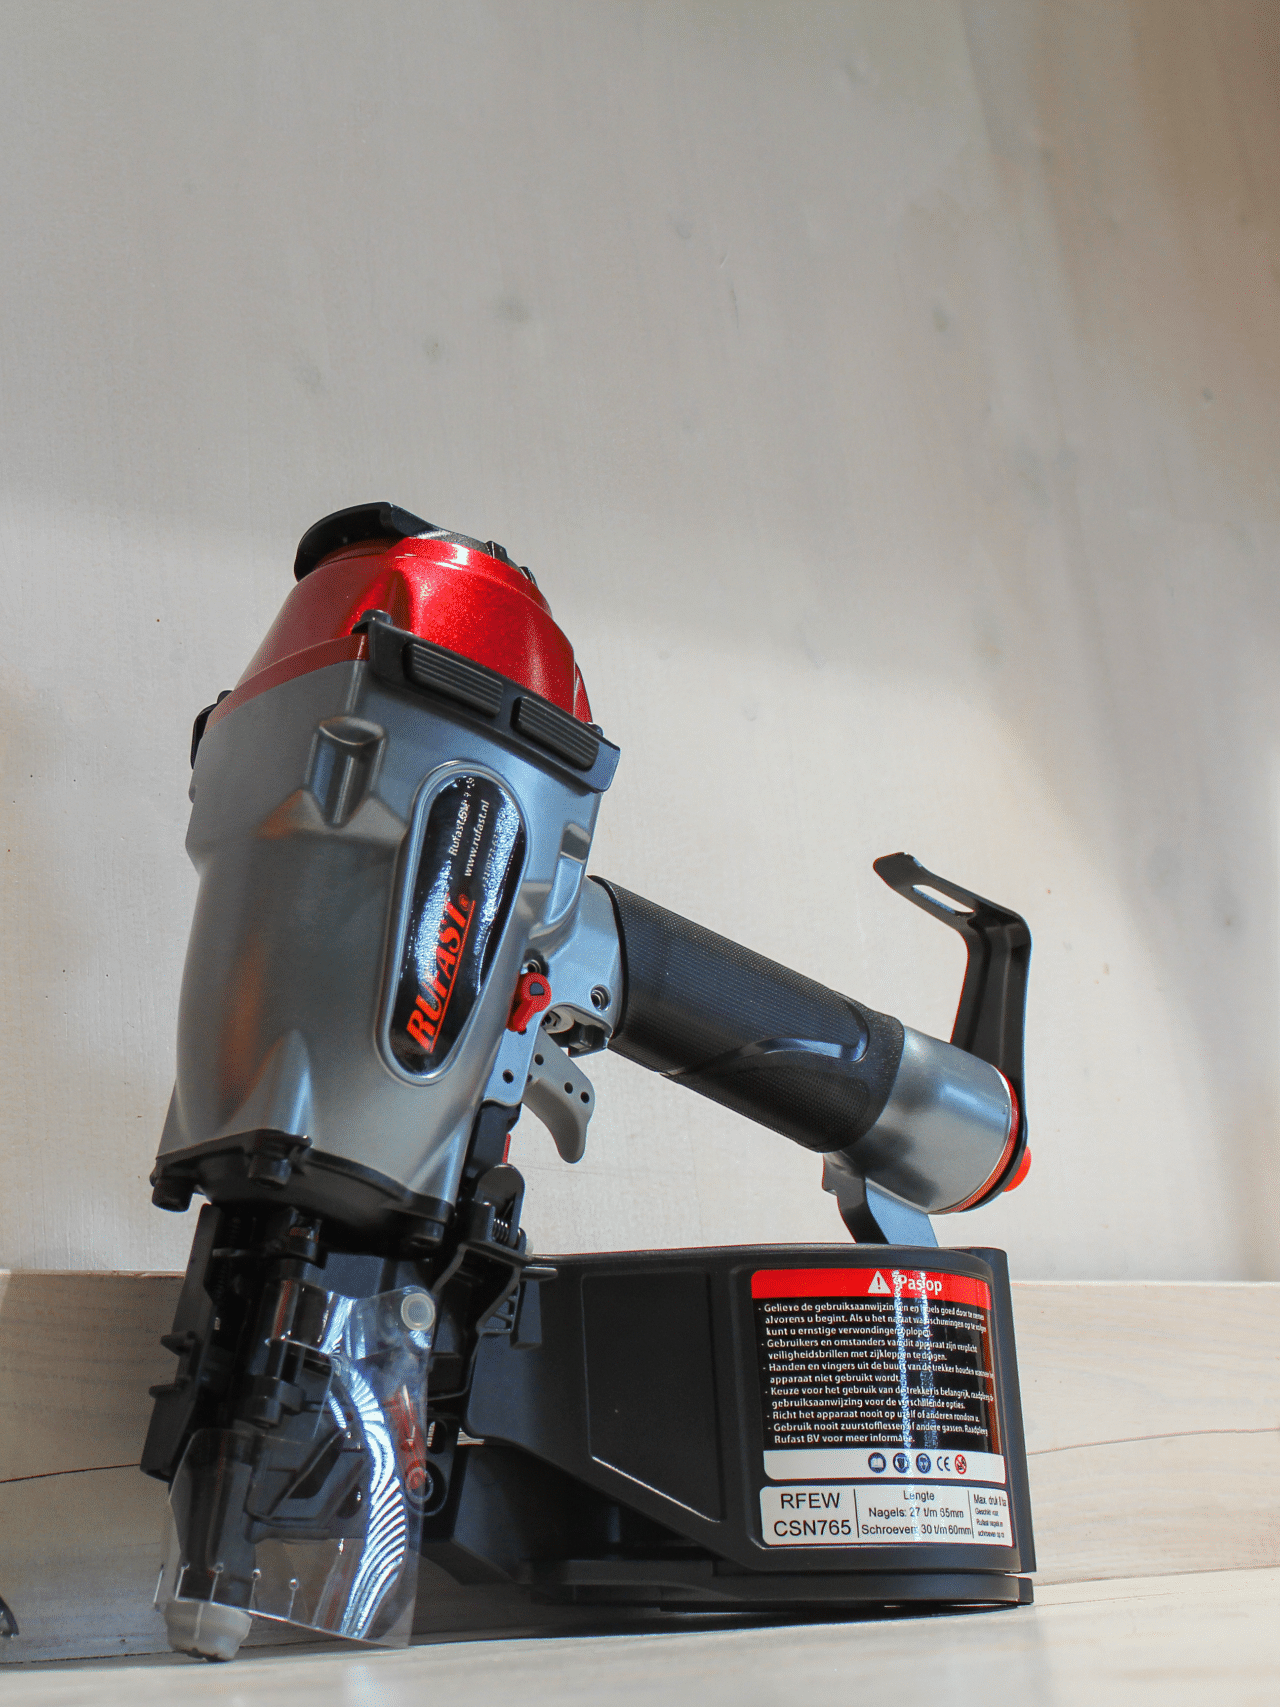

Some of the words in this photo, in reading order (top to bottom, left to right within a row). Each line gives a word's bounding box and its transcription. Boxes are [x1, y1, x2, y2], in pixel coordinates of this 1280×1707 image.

[448, 819, 465, 856] Rufast
[464, 799, 490, 877] www.rufast.nl
[406, 892, 467, 1051] RUFAST
[926, 1279, 942, 1296] op
[763, 1303, 800, 1312] Gelieve
[801, 1302, 813, 1311] de
[814, 1302, 909, 1313] gebruiksaanwijzinn
[909, 1305, 920, 1313] en
[940, 1306, 956, 1317] goed
[765, 1315, 805, 1324] alvorens
[815, 1314, 848, 1324] begint.
[849, 1314, 863, 1323] Als
[871, 1314, 887, 1322] het
[887, 1314, 913, 1324] naaat
[766, 1327, 789, 1336] kunt
[798, 1326, 837, 1336] ernstige
[766, 1339, 819, 1348] Gebruikers
[820, 1339, 833, 1347] en
[833, 1337, 886, 1347] omstanders
[903, 1338, 914, 1347] dit
[946, 1341, 957, 1351] zijn
[768, 1350, 849, 1361] veiligheidsbrillen
[850, 1350, 868, 1358] met
[912, 1351, 921, 1359] te
[768, 1363, 806, 1372] Handen
[808, 1363, 820, 1371] en
[821, 1361, 856, 1372] vingers
[857, 1361, 870, 1370] uit
[871, 1361, 882, 1370] de
[883, 1361, 906, 1370] buu
[907, 1363, 922, 1371] van
[932, 1363, 955, 1373] trekker
[770, 1375, 813, 1385] apparaat
[814, 1373, 833, 1382] niet
[834, 1373, 873, 1384] gebruikt
[770, 1386, 800, 1396] Keuze
[801, 1387, 824, 1395] voor
[825, 1385, 841, 1394] het
[842, 1385, 877, 1396] gebruik
[878, 1386, 894, 1394] van
[933, 1387, 939, 1396] is
[772, 1397, 863, 1409] gebruiksaanwijzing
[864, 1398, 884, 1406] voor
[885, 1397, 897, 1406] de
[897, 1397, 945, 1408] vschillende
[945, 1400, 966, 1410] opties.
[772, 1410, 797, 1419] Richt
[798, 1410, 815, 1419] het
[816, 1410, 858, 1420] apparaat
[859, 1409, 883, 1418] nooit
[884, 1411, 896, 1420] op
[897, 1409, 916, 1419] uelf
[916, 1410, 925, 1418] of
[925, 1411, 953, 1420] anderen
[773, 1422, 812, 1432] Gebruik
[813, 1422, 839, 1431] nooit
[840, 1421, 904, 1430] zuurstofflessen
[915, 1422, 941, 1431] andere
[941, 1424, 964, 1434] gassen.
[774, 1434, 805, 1444] Rufast
[806, 1434, 820, 1442] BV
[821, 1434, 844, 1442] voor
[845, 1434, 868, 1442] meer
[869, 1433, 915, 1443] informae.
[780, 1492, 840, 1509] RFEW
[903, 1490, 935, 1502] Lengte
[868, 1507, 907, 1520] Nagels:
[909, 1506, 921, 1517] 27
[923, 1507, 938, 1518] t/m
[773, 1519, 852, 1537] CSN765
[921, 1524, 933, 1535] 30
[933, 1524, 948, 1535] t/m
[948, 1524, 972, 1536] 60mm
